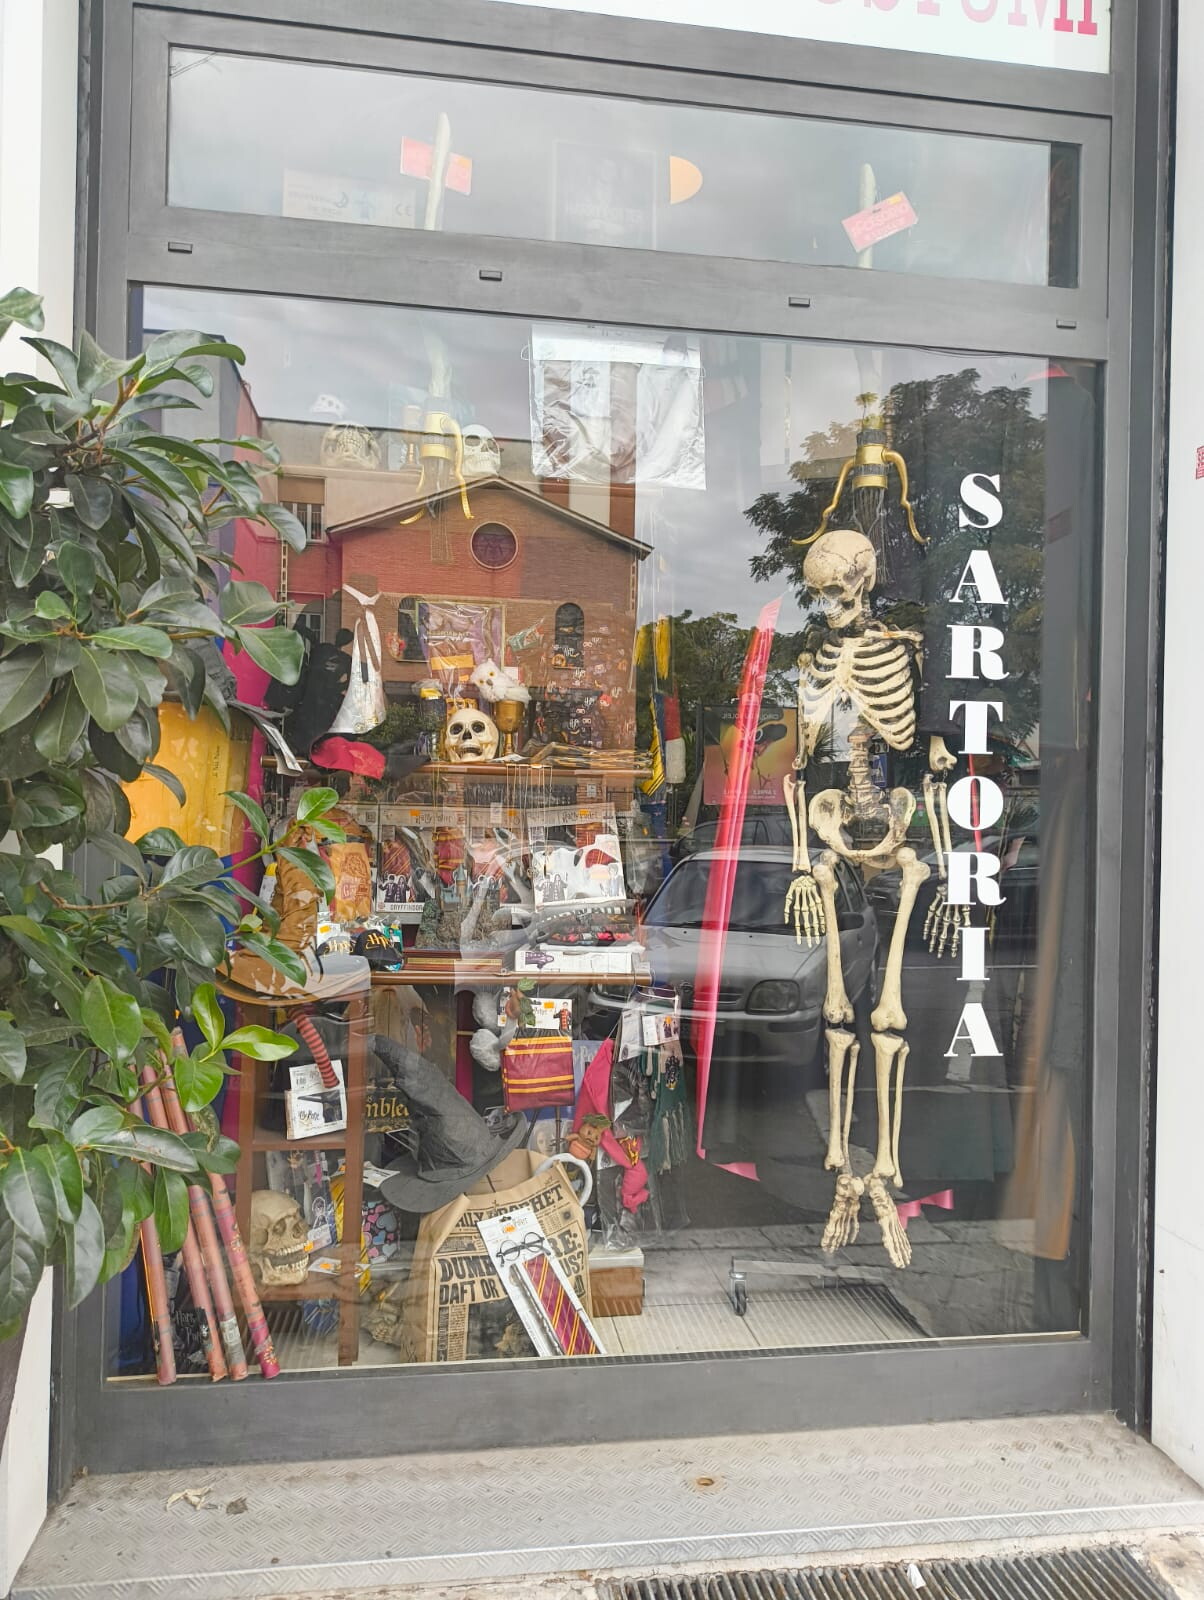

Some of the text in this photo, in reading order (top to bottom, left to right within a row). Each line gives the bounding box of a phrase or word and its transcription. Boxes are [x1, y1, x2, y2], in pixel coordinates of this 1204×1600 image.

[943, 472, 1010, 1058] SARTORIA
[439, 1280, 476, 1305] DAFT
[480, 1278, 500, 1299] OR
